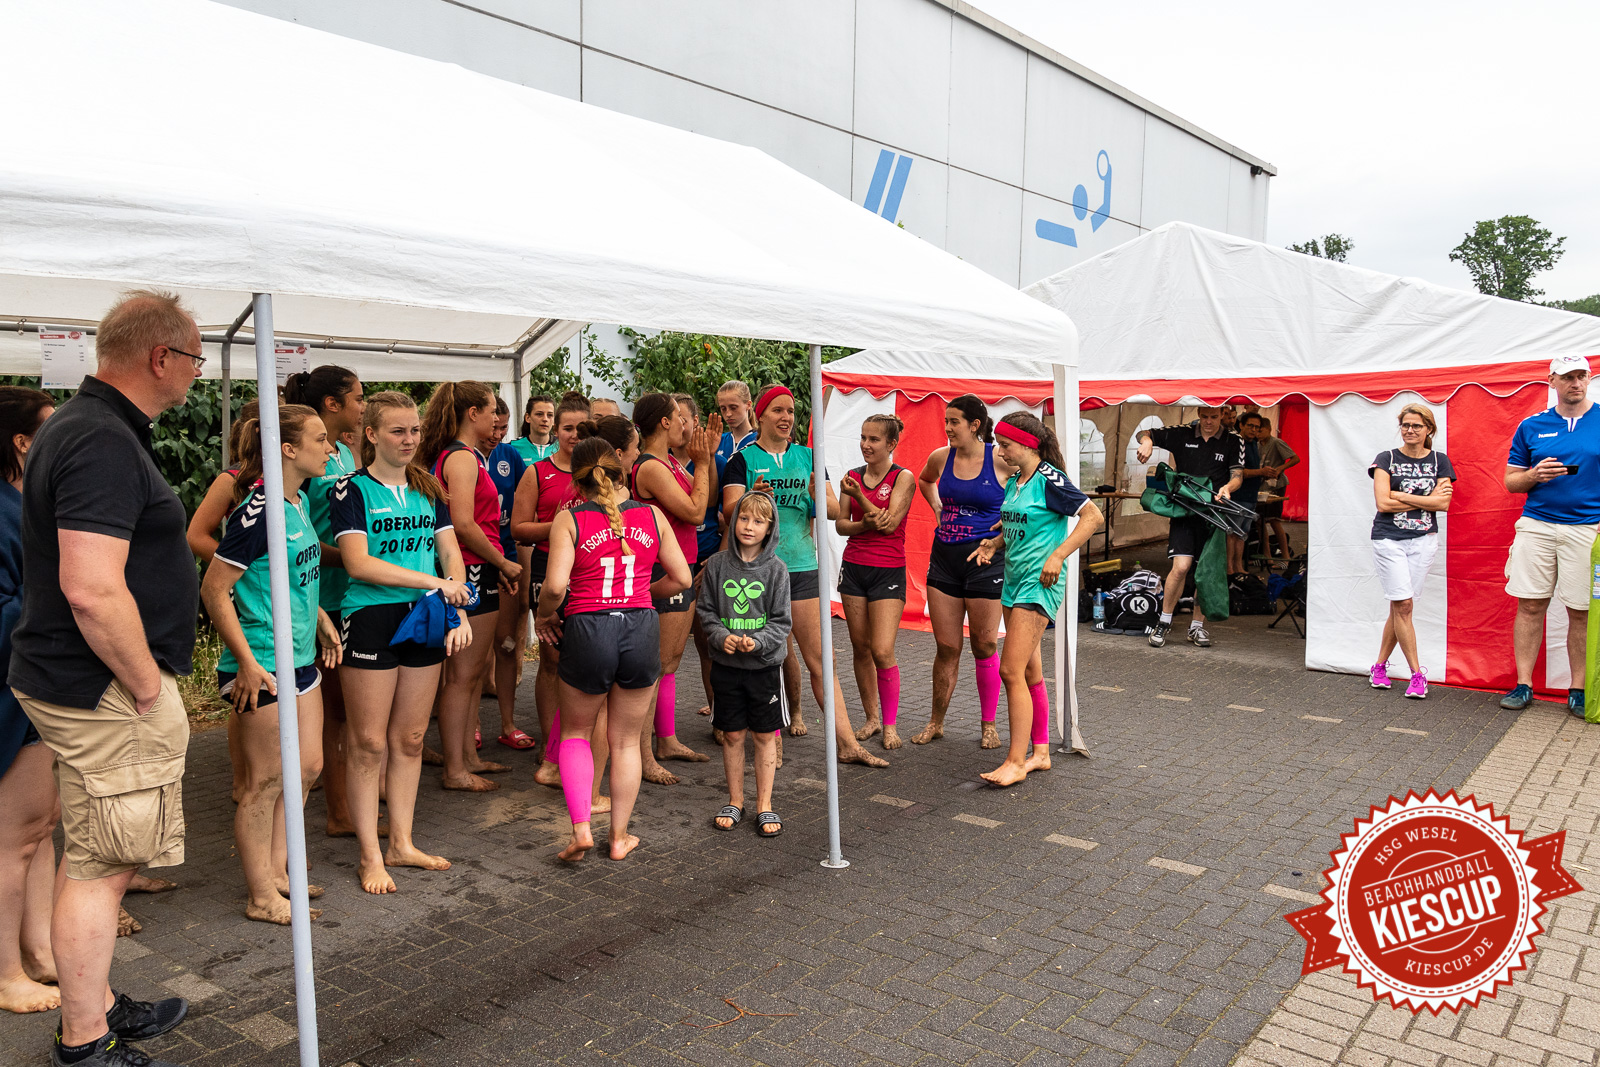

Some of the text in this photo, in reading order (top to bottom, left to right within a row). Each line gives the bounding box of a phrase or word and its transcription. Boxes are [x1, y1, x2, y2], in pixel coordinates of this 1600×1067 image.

[1214, 452, 1225, 462] TR
[762, 478, 806, 490] ERLIGA
[379, 536, 434, 555] 2018/19
[600, 554, 636, 598] 11
[352, 651, 378, 661] hummel
